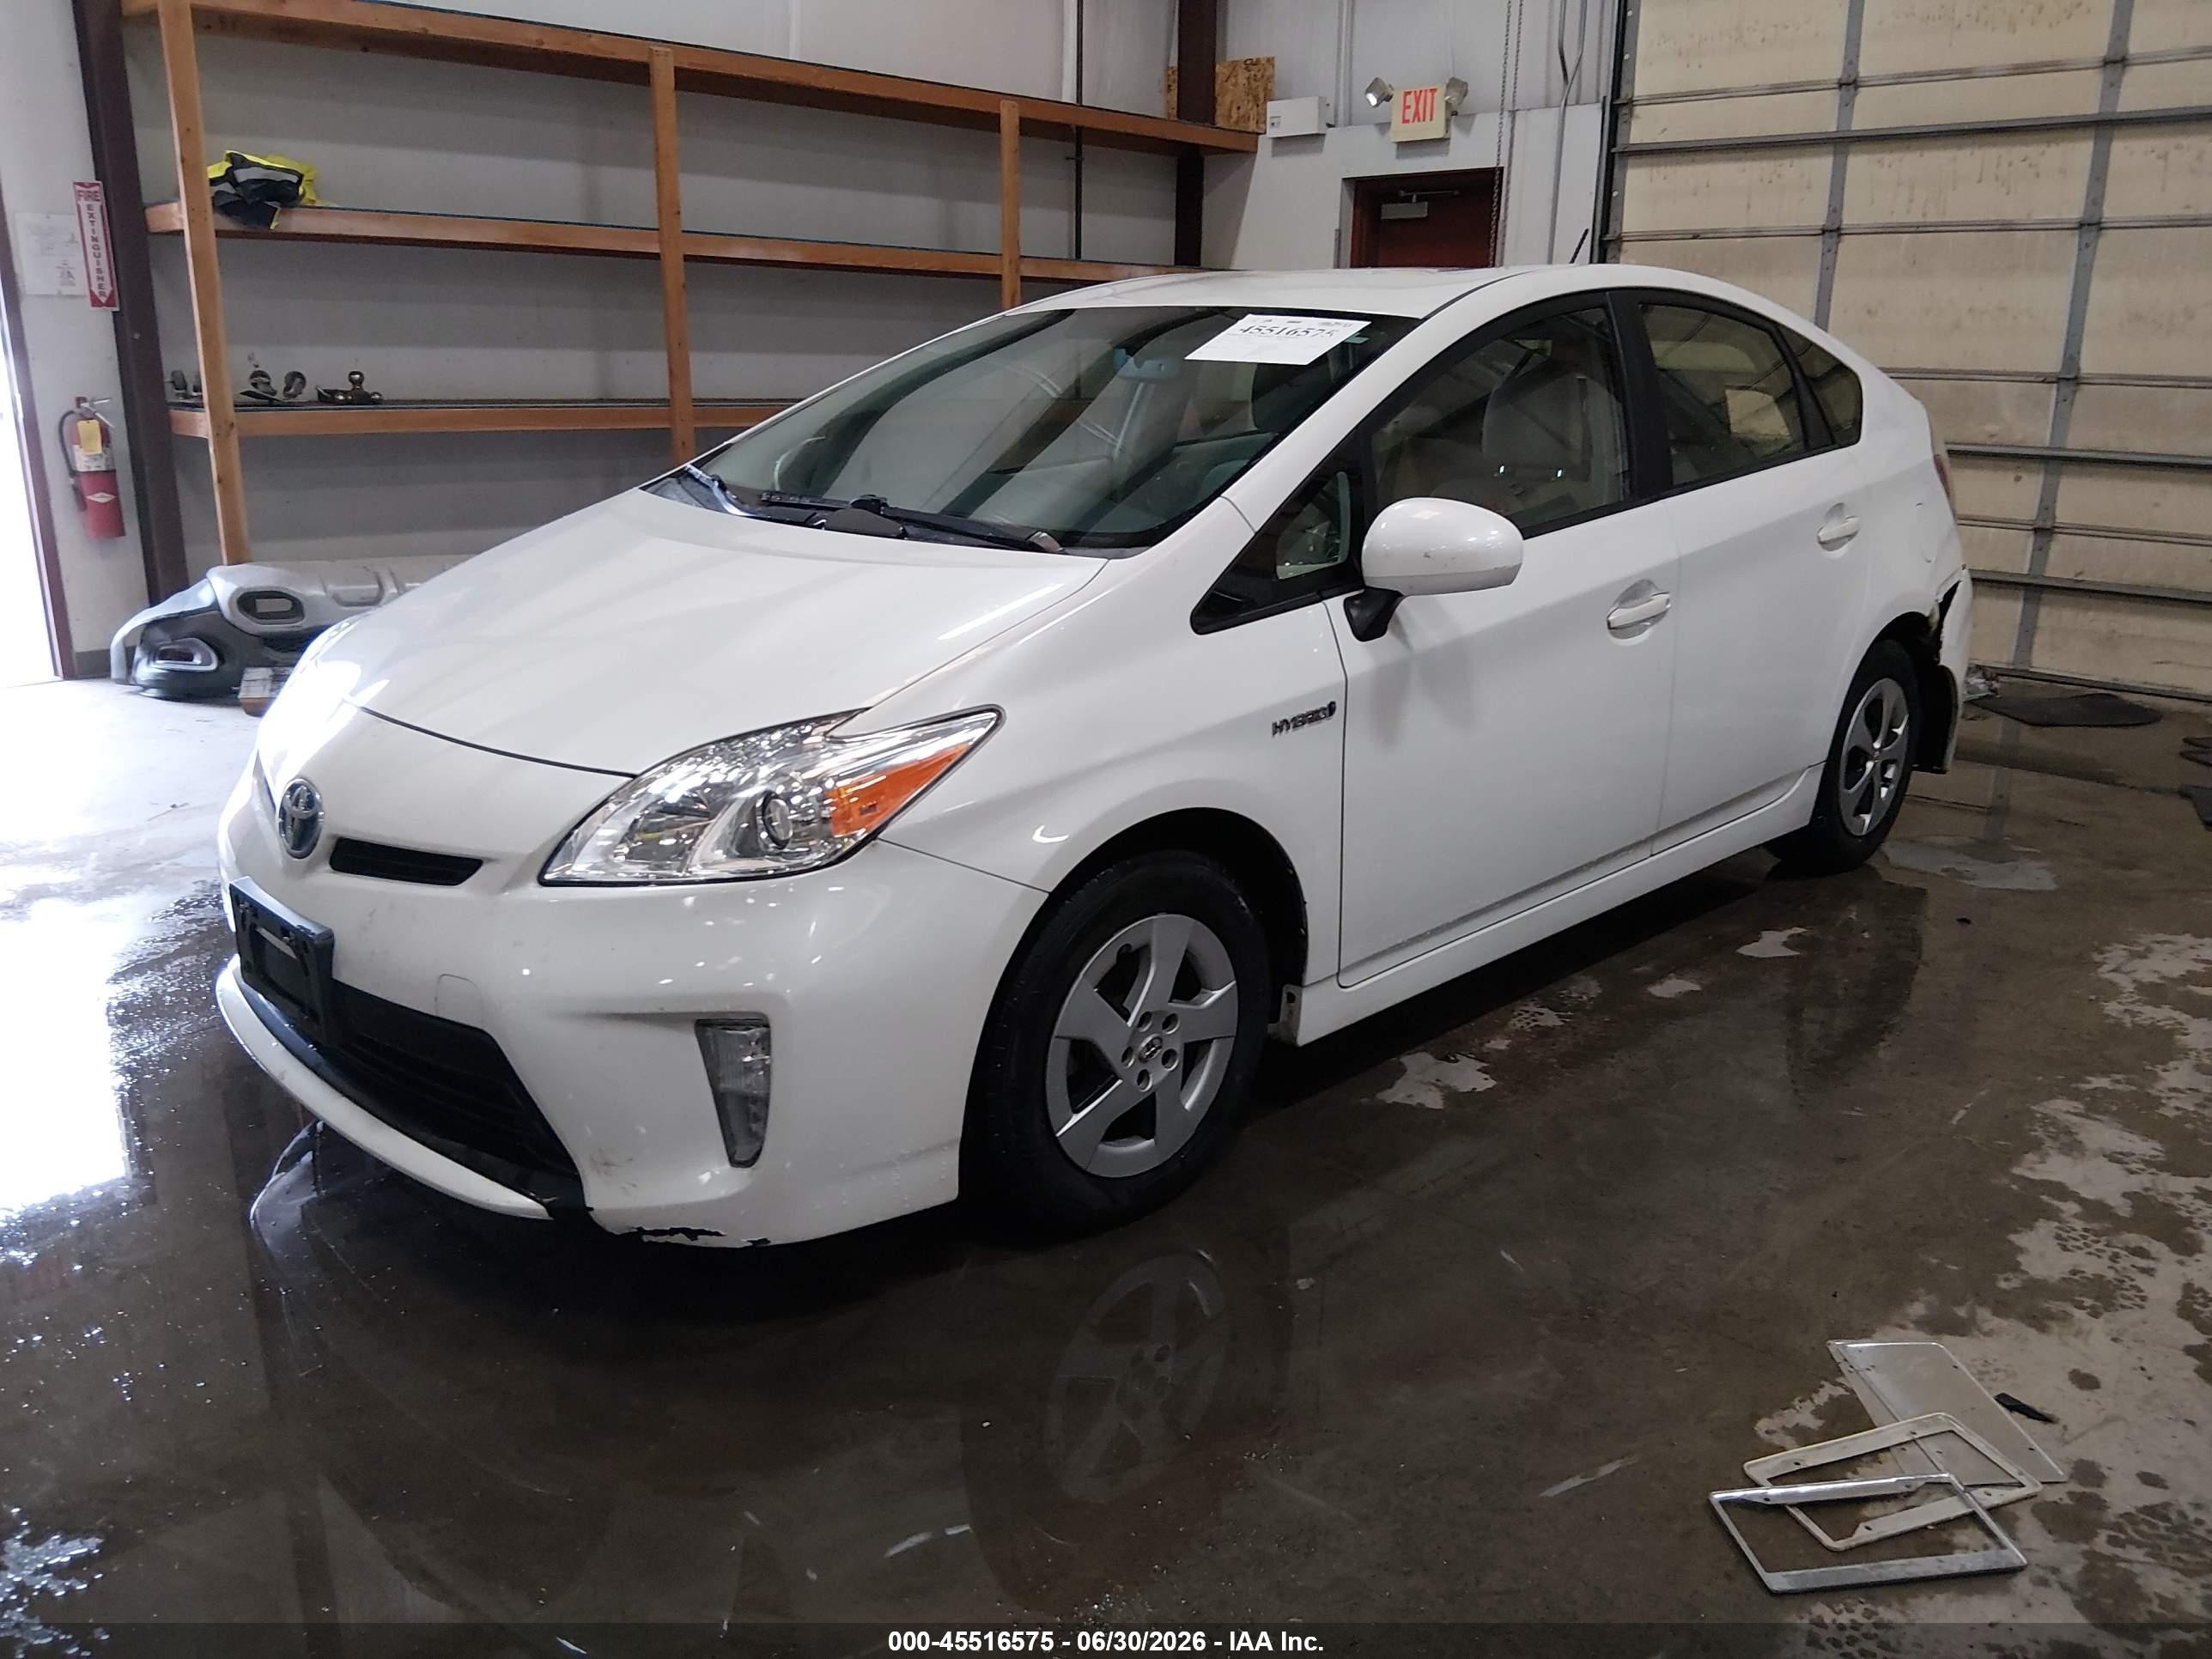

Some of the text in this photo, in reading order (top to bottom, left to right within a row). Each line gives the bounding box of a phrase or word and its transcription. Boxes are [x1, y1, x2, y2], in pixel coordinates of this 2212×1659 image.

[1401, 88, 1438, 125] EXIT
[76, 190, 101, 202] FIRE
[86, 204, 107, 298] EXTINGUISHER
